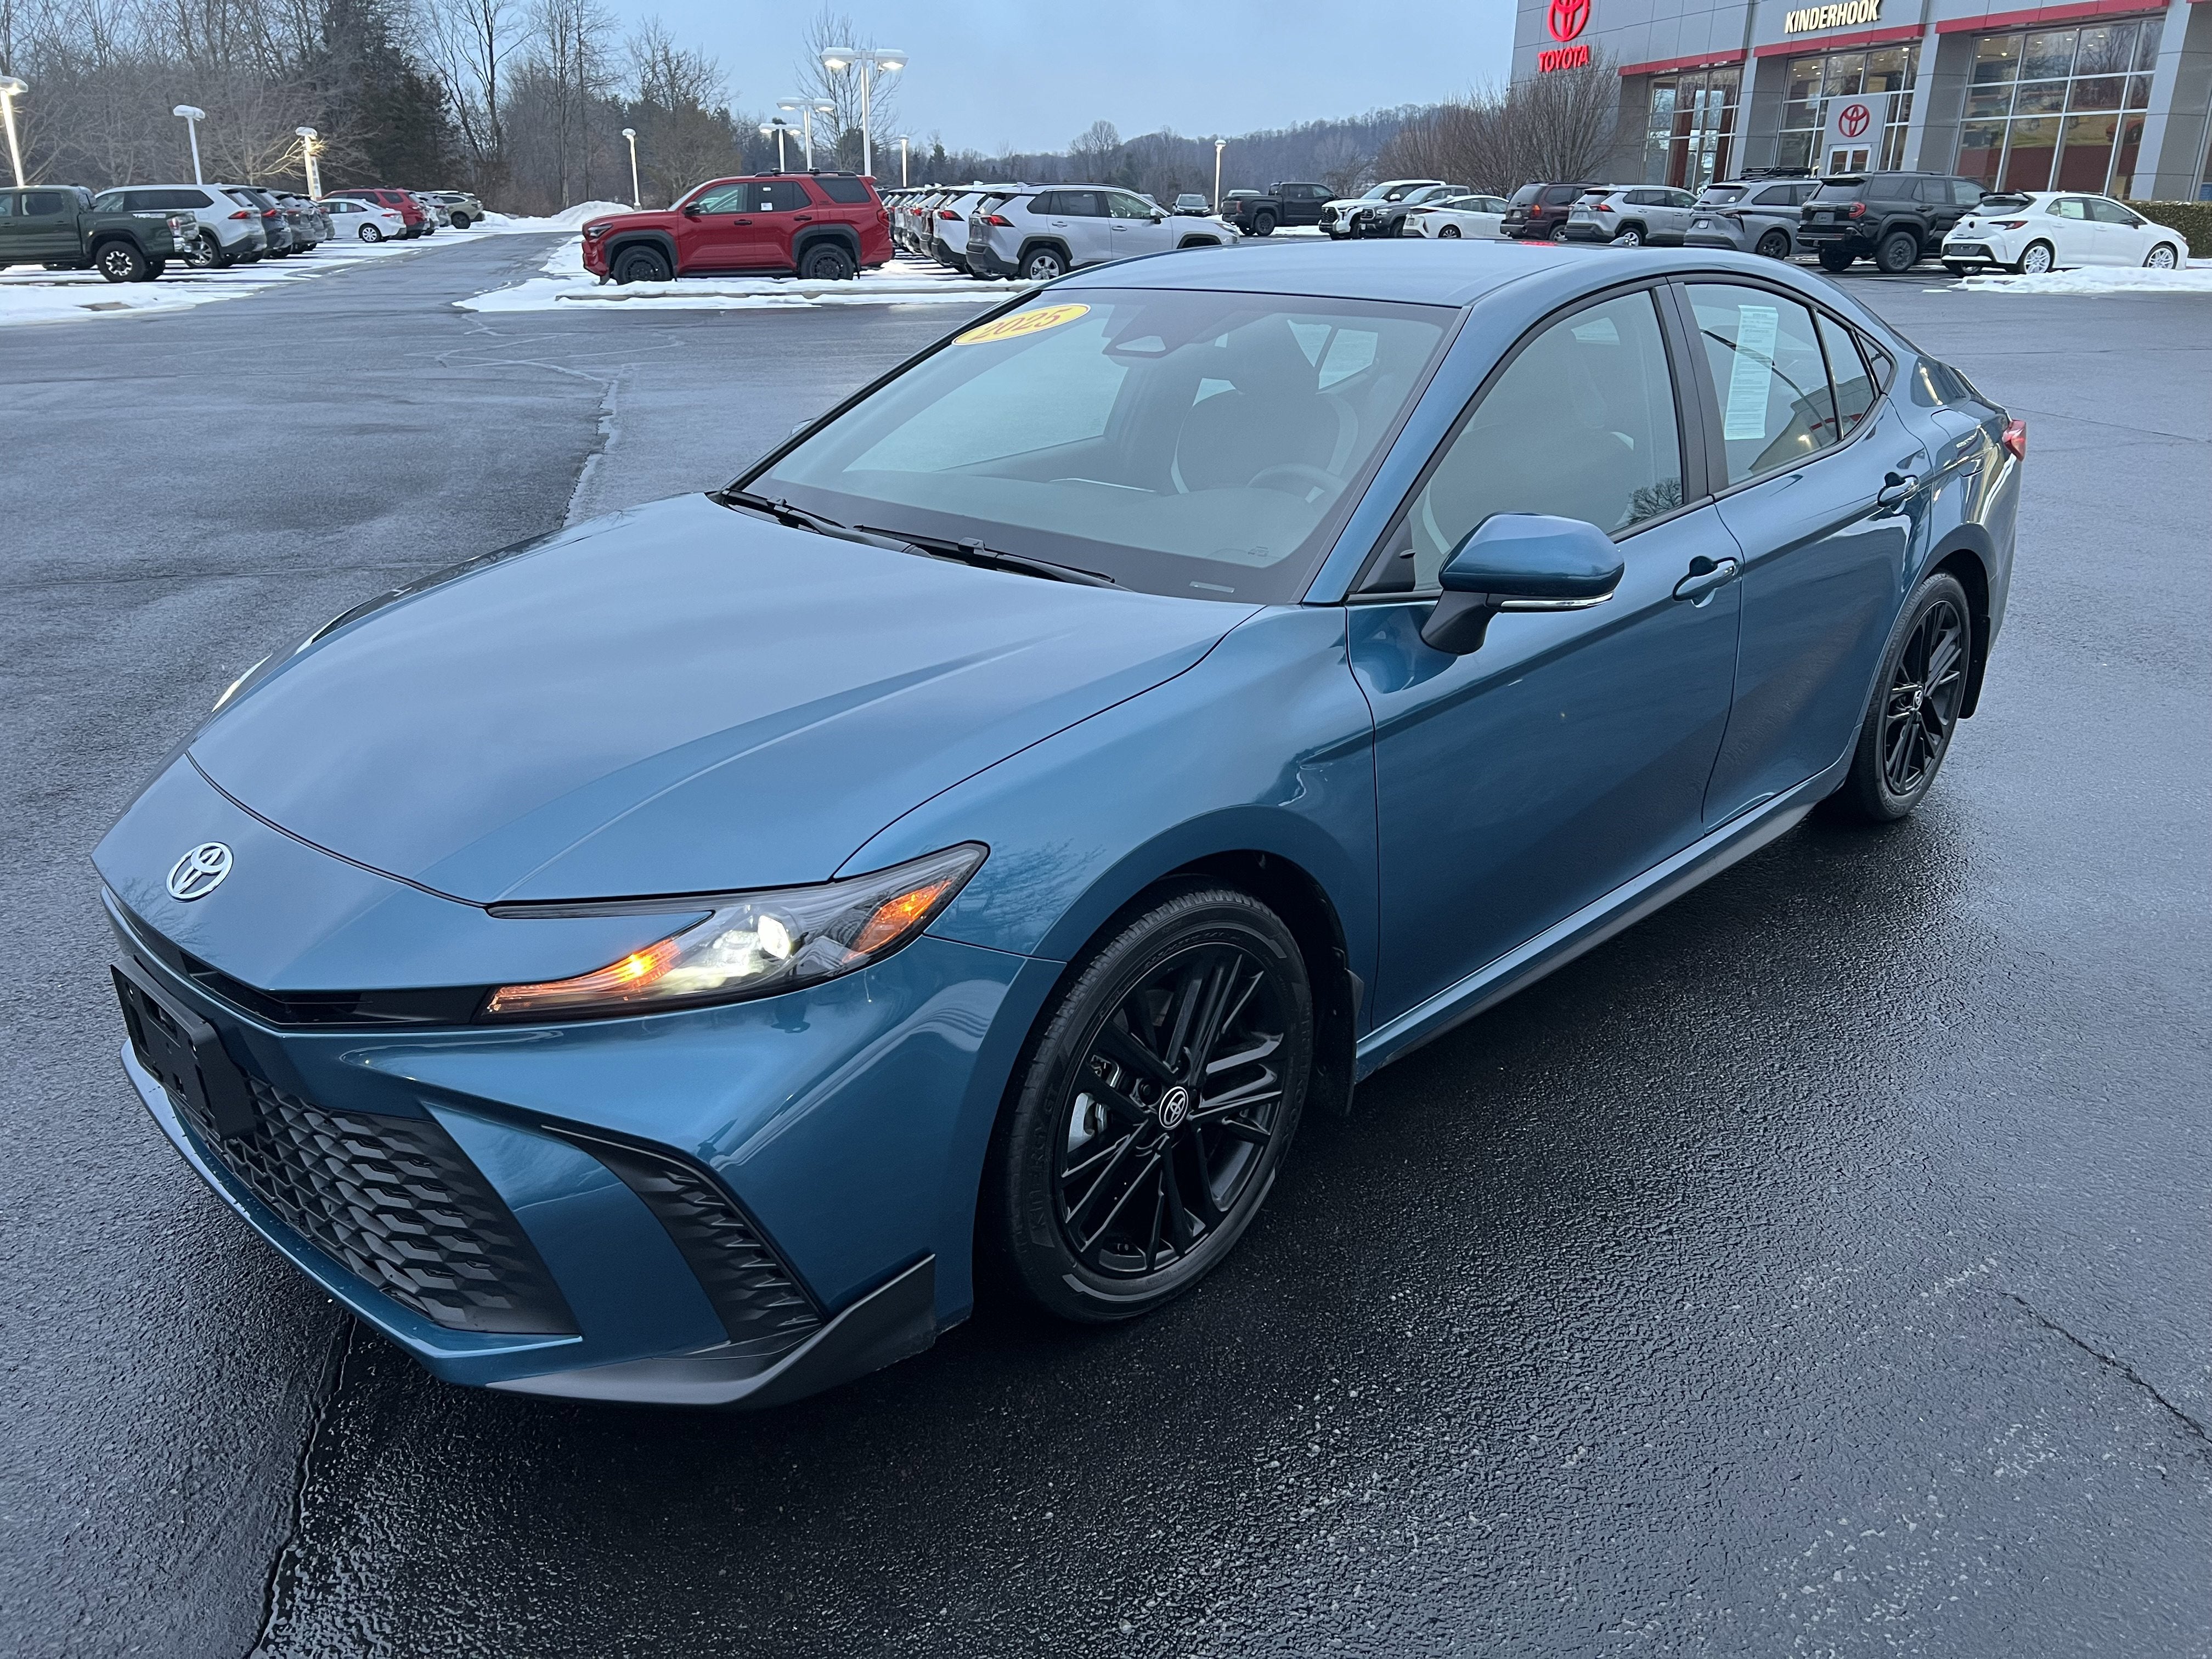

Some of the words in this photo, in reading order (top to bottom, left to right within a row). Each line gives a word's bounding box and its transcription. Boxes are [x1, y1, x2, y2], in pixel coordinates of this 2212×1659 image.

[1785, 0, 1880, 33] KINDERHOOK
[1538, 44, 1589, 73] TOYOTA
[968, 308, 1073, 341] 2025
